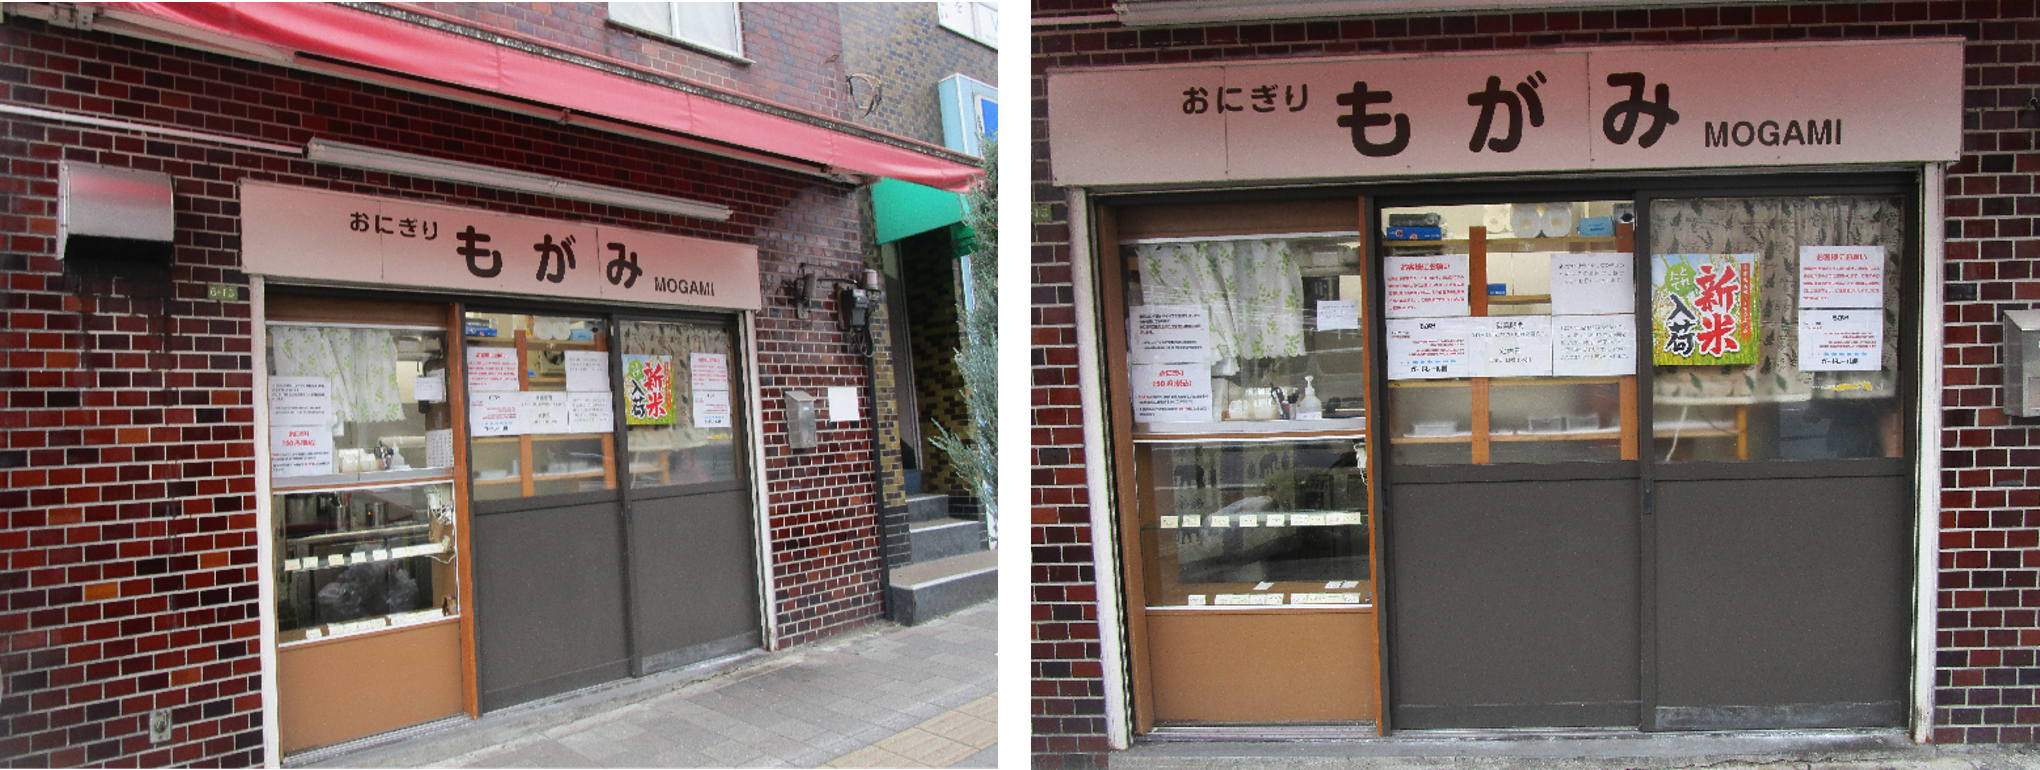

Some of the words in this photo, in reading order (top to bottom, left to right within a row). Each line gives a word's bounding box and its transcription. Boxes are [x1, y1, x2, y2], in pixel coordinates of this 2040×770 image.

[1182, 84, 1309, 115] おにぎり
[1336, 71, 1680, 157] もがみ
[1704, 118, 1842, 148] MOGAMI
[349, 211, 438, 241] おにぎり
[456, 225, 643, 290] もがみ
[654, 276, 715, 297] MOGAMI
[210, 287, 235, 298] 6-13
[1694, 265, 1739, 355] 新米
[1663, 293, 1696, 356] 入荷
[631, 379, 646, 418] 入荷
[642, 361, 667, 418] 新米
